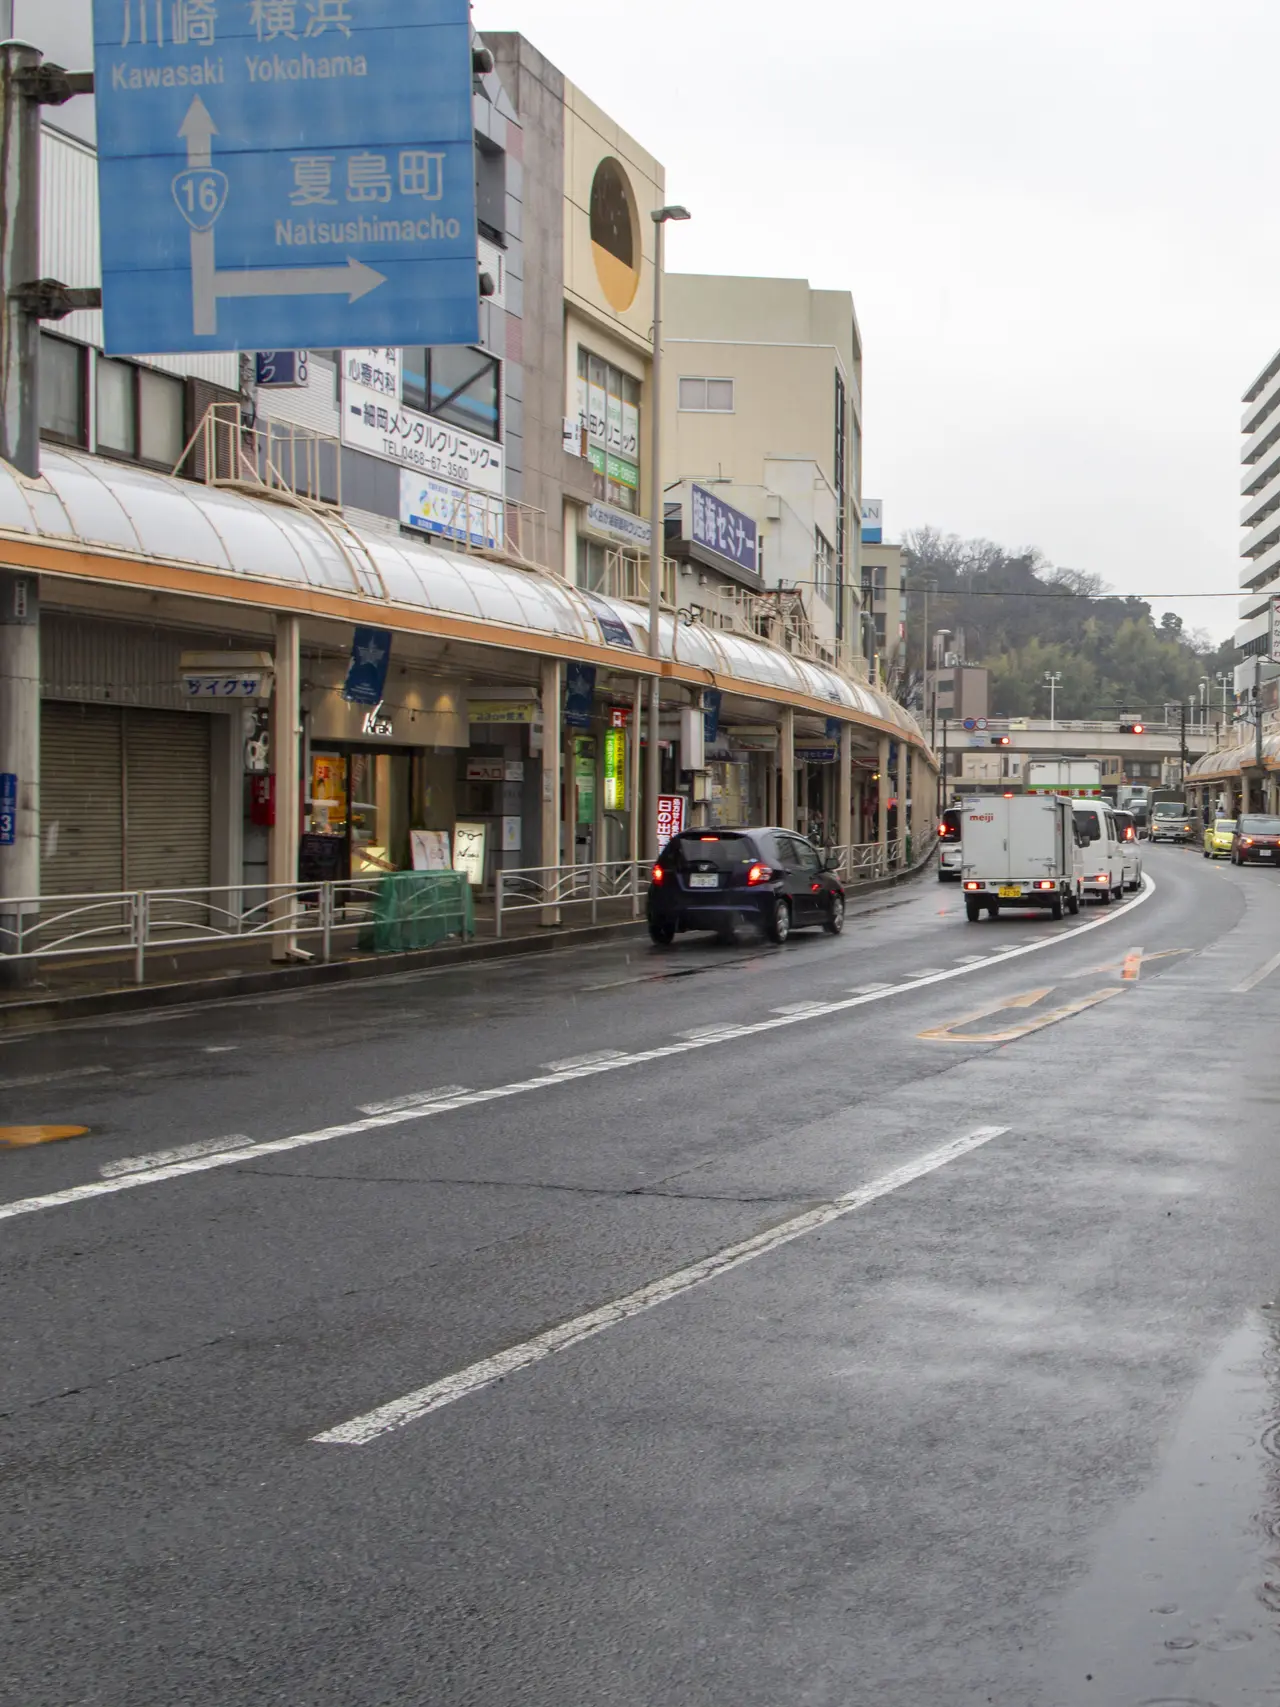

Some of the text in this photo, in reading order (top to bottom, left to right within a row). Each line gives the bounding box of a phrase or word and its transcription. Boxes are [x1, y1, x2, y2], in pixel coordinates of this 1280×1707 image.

[121, 0, 353, 47] 川崎 横浜
[111, 53, 368, 91] Kawasaki Yokohama
[180, 178, 217, 213] 16
[288, 150, 447, 206] 夏島町
[275, 214, 460, 246] Natsushimacho
[351, 358, 397, 397] 心療内科
[969, 812, 994, 823] meiji
